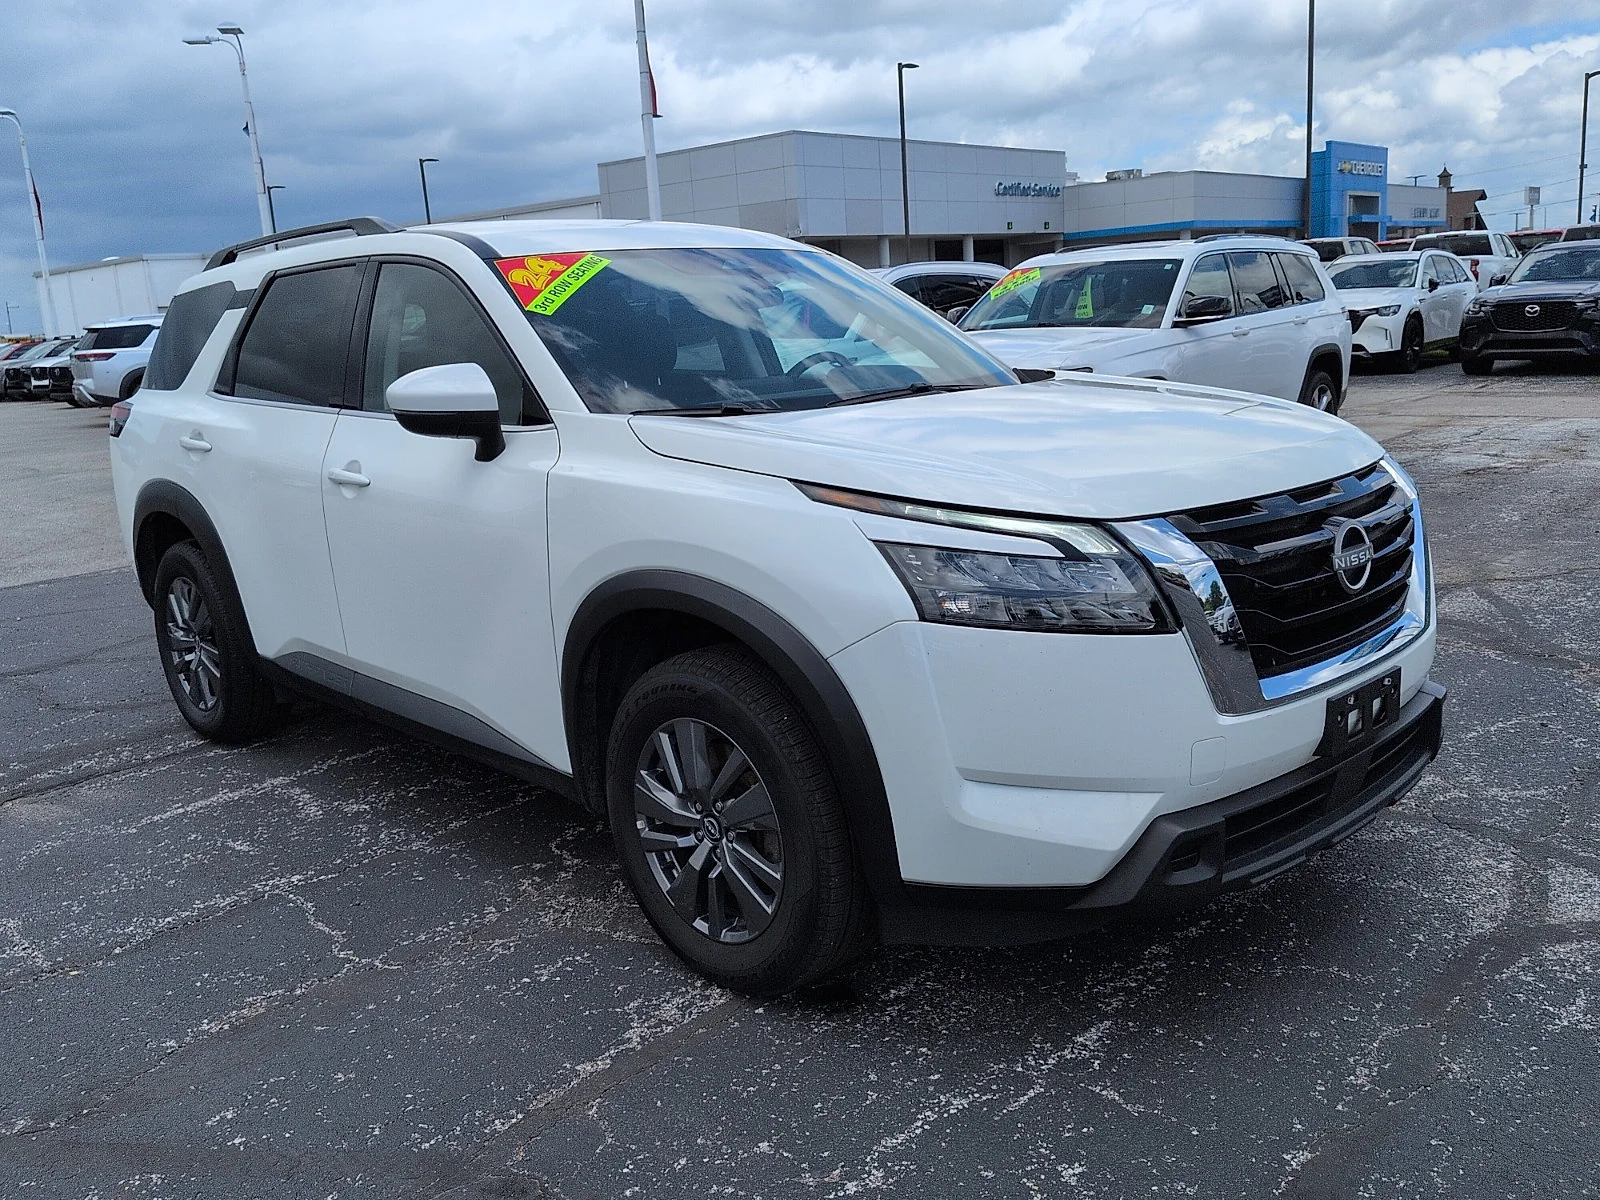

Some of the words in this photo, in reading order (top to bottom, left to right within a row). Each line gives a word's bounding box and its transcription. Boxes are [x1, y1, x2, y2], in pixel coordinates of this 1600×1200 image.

[1351, 161, 1384, 176] CHEVROLET
[995, 182, 1031, 197] Certified
[1031, 183, 1061, 197] Service
[534, 296, 555, 312] 3rd
[548, 278, 573, 298] ROW
[566, 256, 603, 281] SEATING
[1335, 548, 1371, 569] NISSA
[634, 684, 698, 707] TOURING
